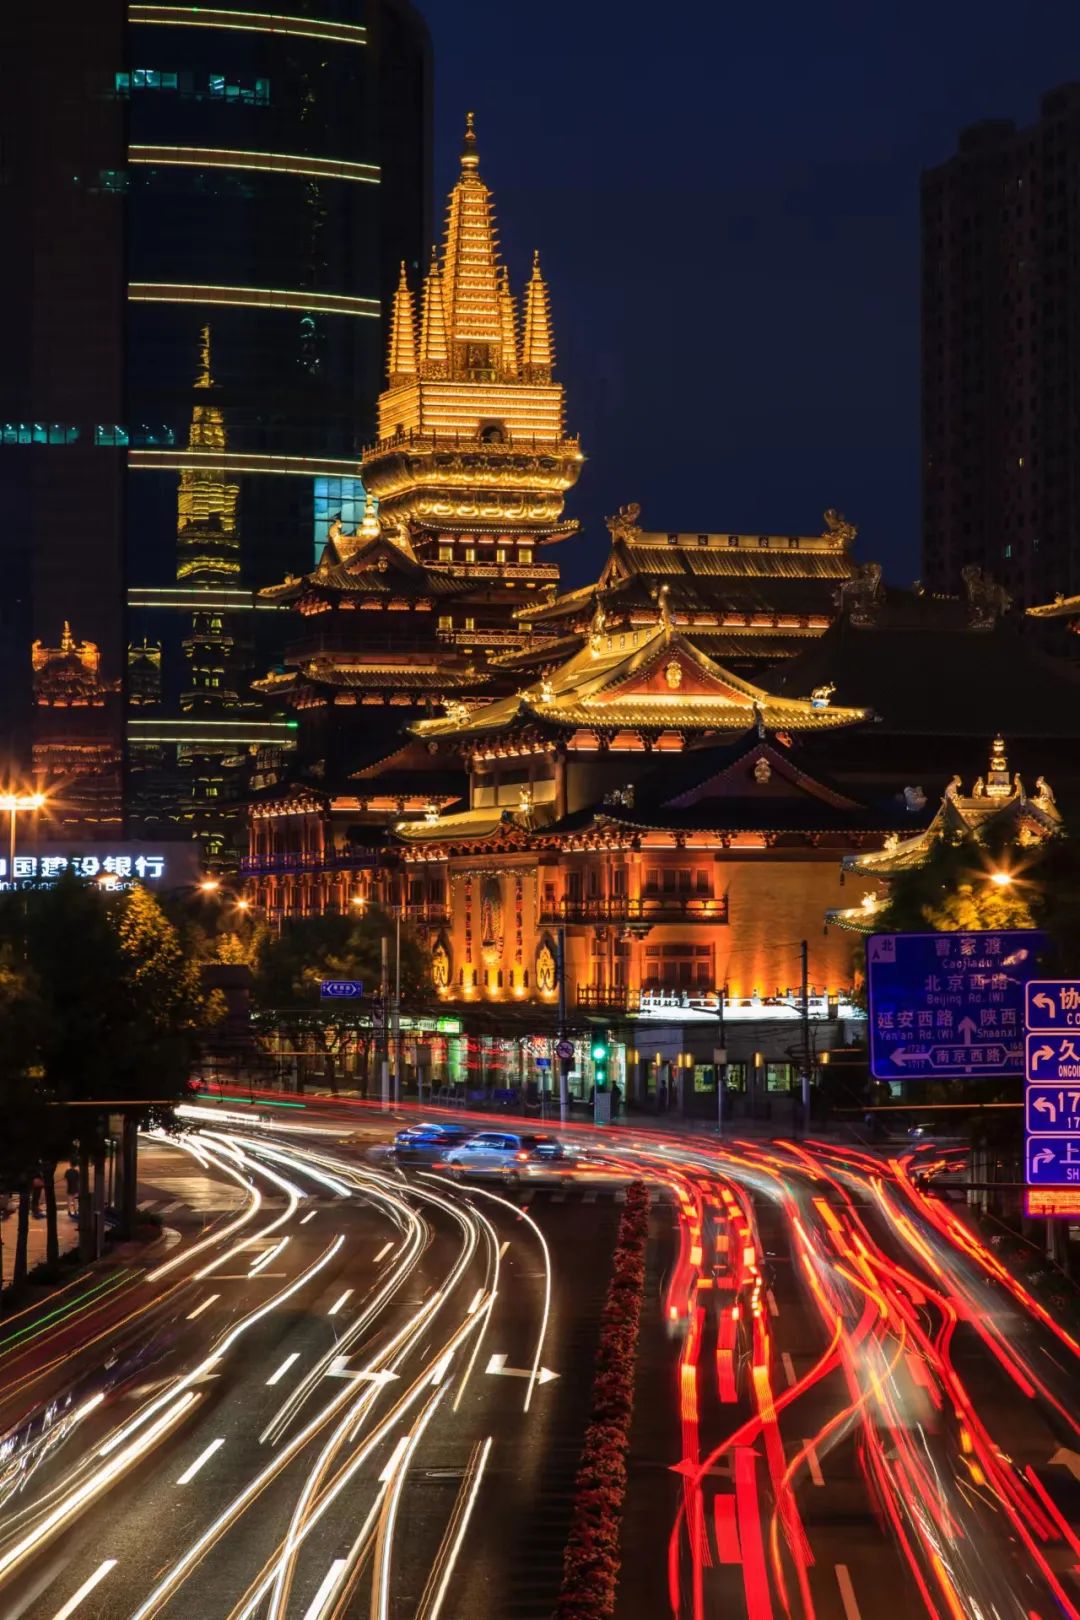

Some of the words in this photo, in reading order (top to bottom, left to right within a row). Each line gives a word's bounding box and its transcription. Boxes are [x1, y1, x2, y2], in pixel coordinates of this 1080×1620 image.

[882, 939, 893, 952] 北
[935, 937, 1002, 957] 曹家渡
[924, 972, 1008, 992] 北京西路
[926, 993, 962, 1007] Beijing
[877, 1009, 954, 1029] 延安西路
[979, 1008, 1024, 1027] 陕西
[977, 1027, 1016, 1039] Shaanxi
[936, 1048, 1001, 1063] 南京西路
[1058, 1091, 1080, 1113] 17
[1059, 1142, 1080, 1164] 上
[1066, 1167, 1080, 1180] SH
